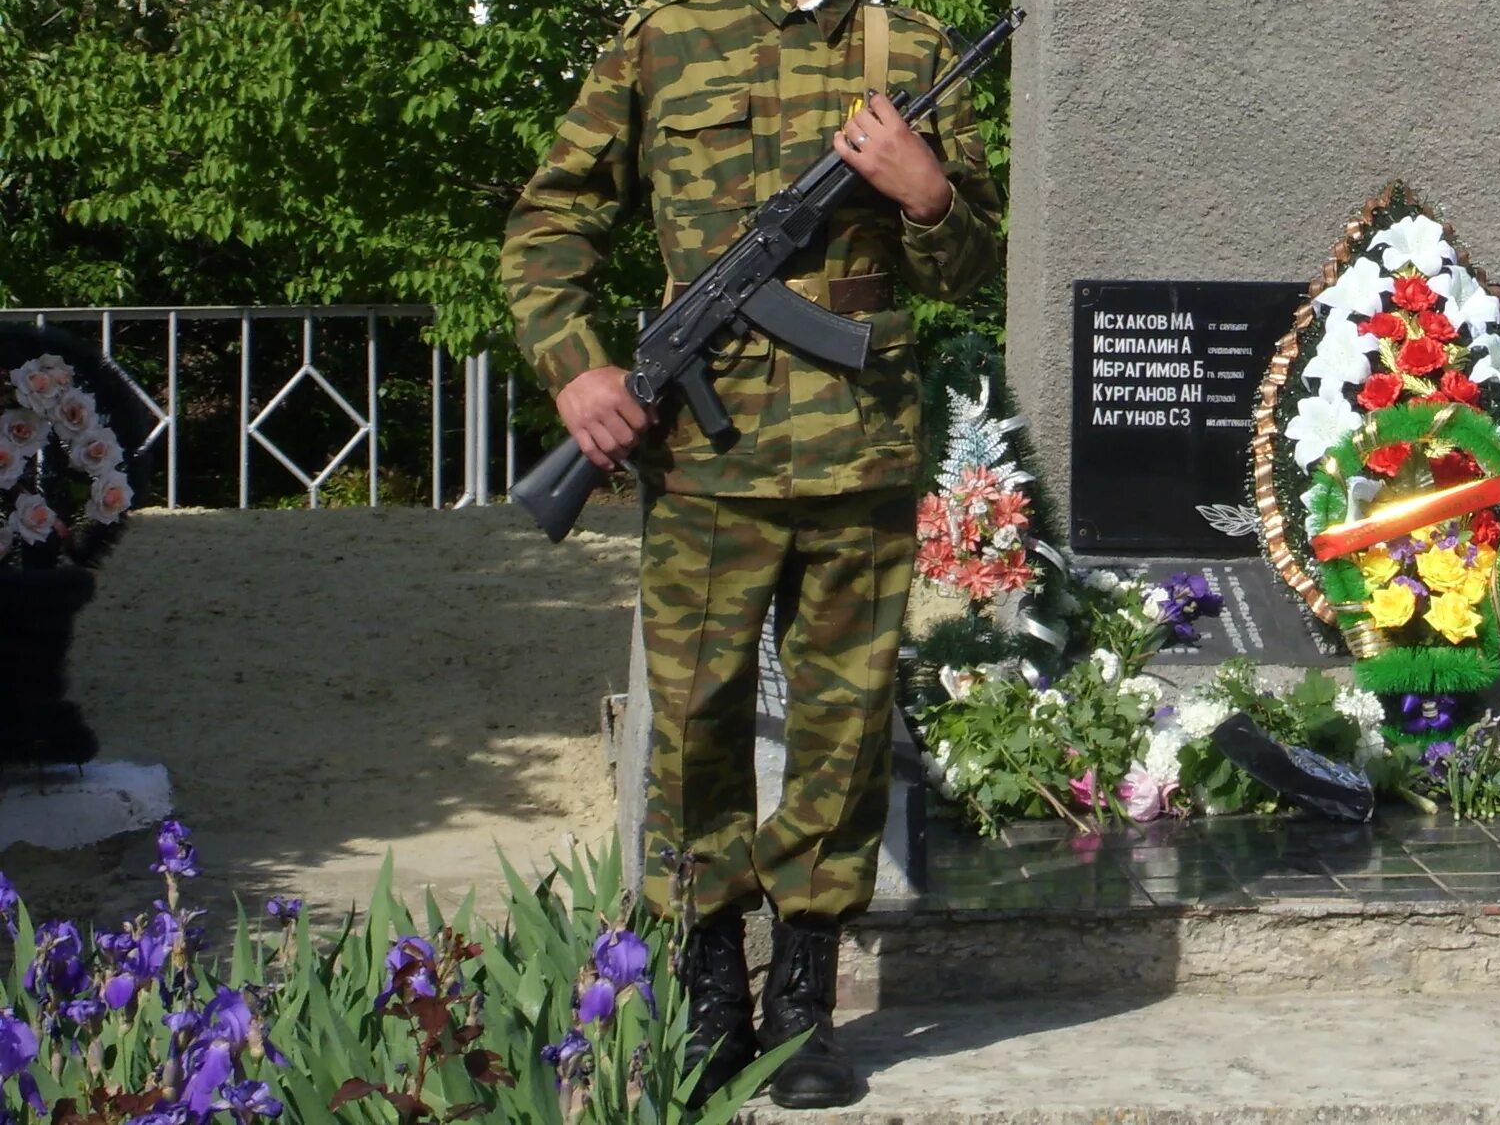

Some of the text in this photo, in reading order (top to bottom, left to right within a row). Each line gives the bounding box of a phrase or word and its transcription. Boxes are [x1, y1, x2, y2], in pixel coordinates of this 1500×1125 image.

[1093, 310, 1168, 330] ИСХАКОВ
[1170, 312, 1195, 331] МА
[1092, 334, 1179, 354] ИСИПАЛИН
[1181, 335, 1193, 355] А
[1092, 358, 1191, 379] ИБРАГИМОВ
[1193, 360, 1205, 379] Б
[1092, 382, 1177, 402] КУРГАНОВ
[1180, 383, 1202, 403] АН
[1091, 406, 1167, 426] ЛАГУНОВ
